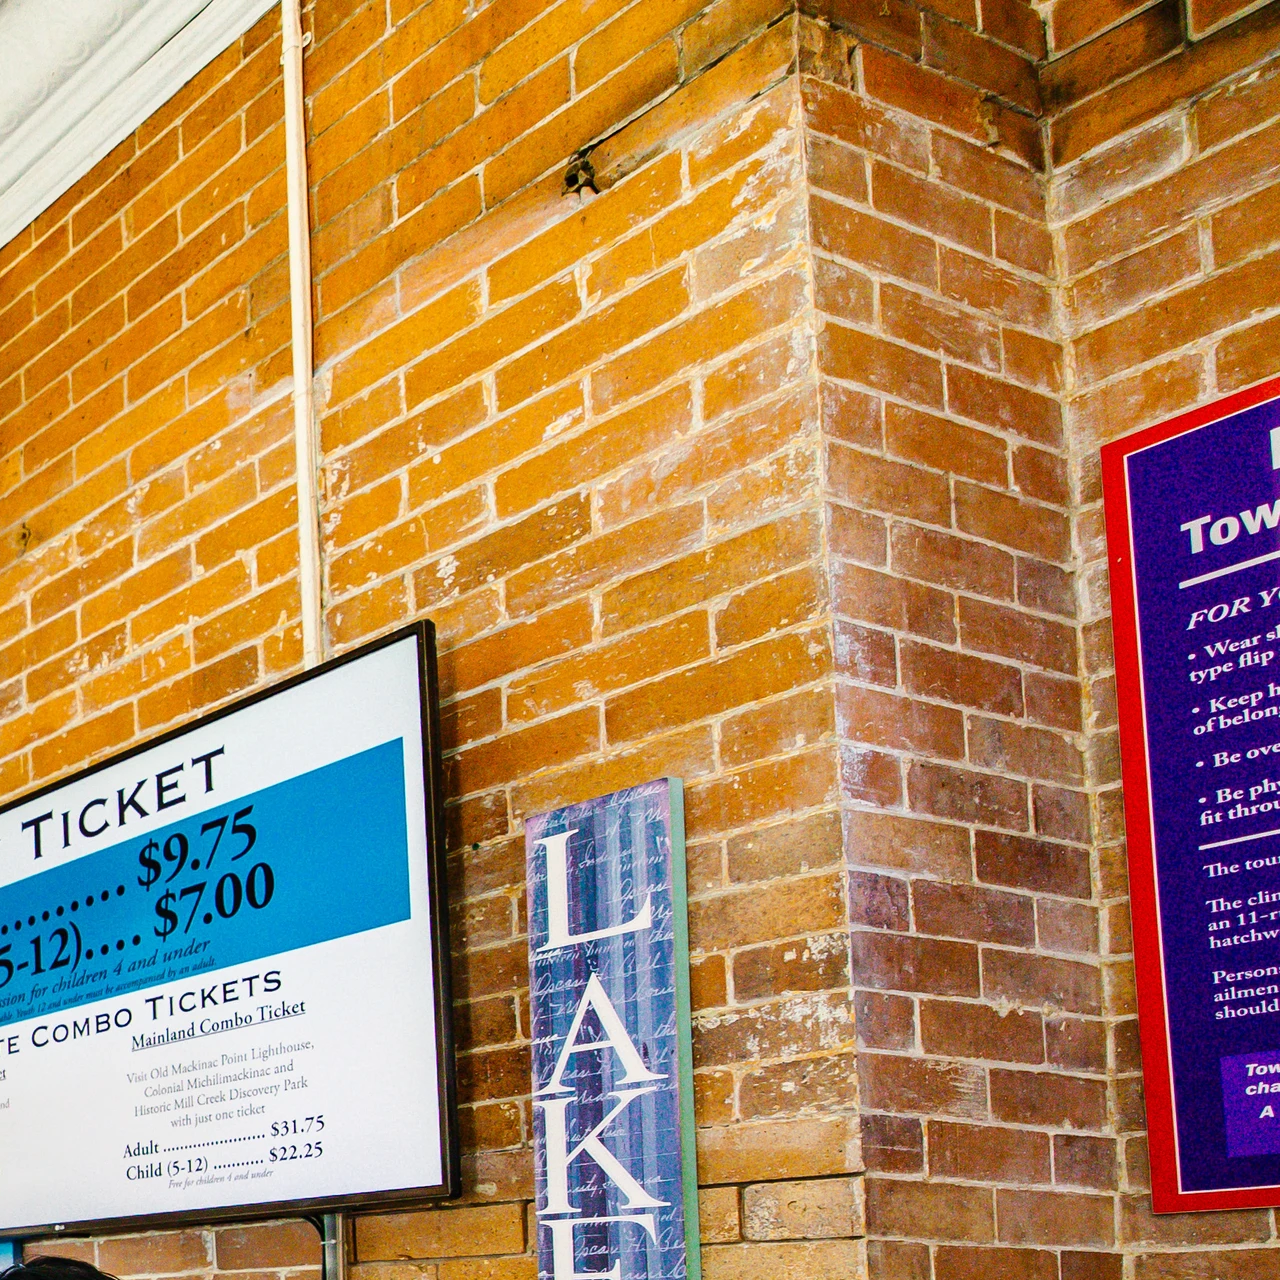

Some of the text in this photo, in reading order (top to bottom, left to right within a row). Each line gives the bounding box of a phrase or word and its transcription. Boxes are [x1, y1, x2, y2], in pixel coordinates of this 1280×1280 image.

[1186, 595, 1251, 632] FOR
[1203, 632, 1262, 660] Wear
[1188, 647, 1275, 686] type flip
[1209, 689, 1263, 715] Keep
[1193, 717, 1217, 736] of
[1213, 751, 1242, 769] Be
[20, 744, 226, 860] TICKET
[1216, 787, 1245, 804] Be
[1199, 809, 1224, 827] fit
[136, 803, 258, 893] $9.75
[1203, 862, 1241, 879] The
[152, 860, 276, 943] $7.00
[1205, 897, 1243, 915] The
[1208, 917, 1230, 932] an
[28, 982, 51, 1006] for
[51, 969, 109, 995] children
[113, 959, 123, 977] 4
[126, 953, 158, 974] and
[161, 938, 212, 964] under
[31, 1007, 133, 1049] COMBO
[144, 970, 283, 1022] TICKETS
[131, 999, 307, 1050] Mainland Combo Ticket
[126, 1040, 316, 1085] Visit Old Mackinac Point Lighthouse,
[143, 1059, 295, 1099] Colonial Michilimackinac and
[134, 1074, 309, 1118] Historic Mill Creek Discovery Park
[1259, 1105, 1276, 1119] A
[169, 1102, 266, 1129] with just one ticket
[123, 1114, 326, 1160] Adult $31.75
[126, 1140, 325, 1182] Child (5-12) $22.25
[168, 1178, 183, 1190] Free
[195, 1171, 226, 1187] children
[233, 1169, 251, 1182] and
[250, 1168, 275, 1181] under
